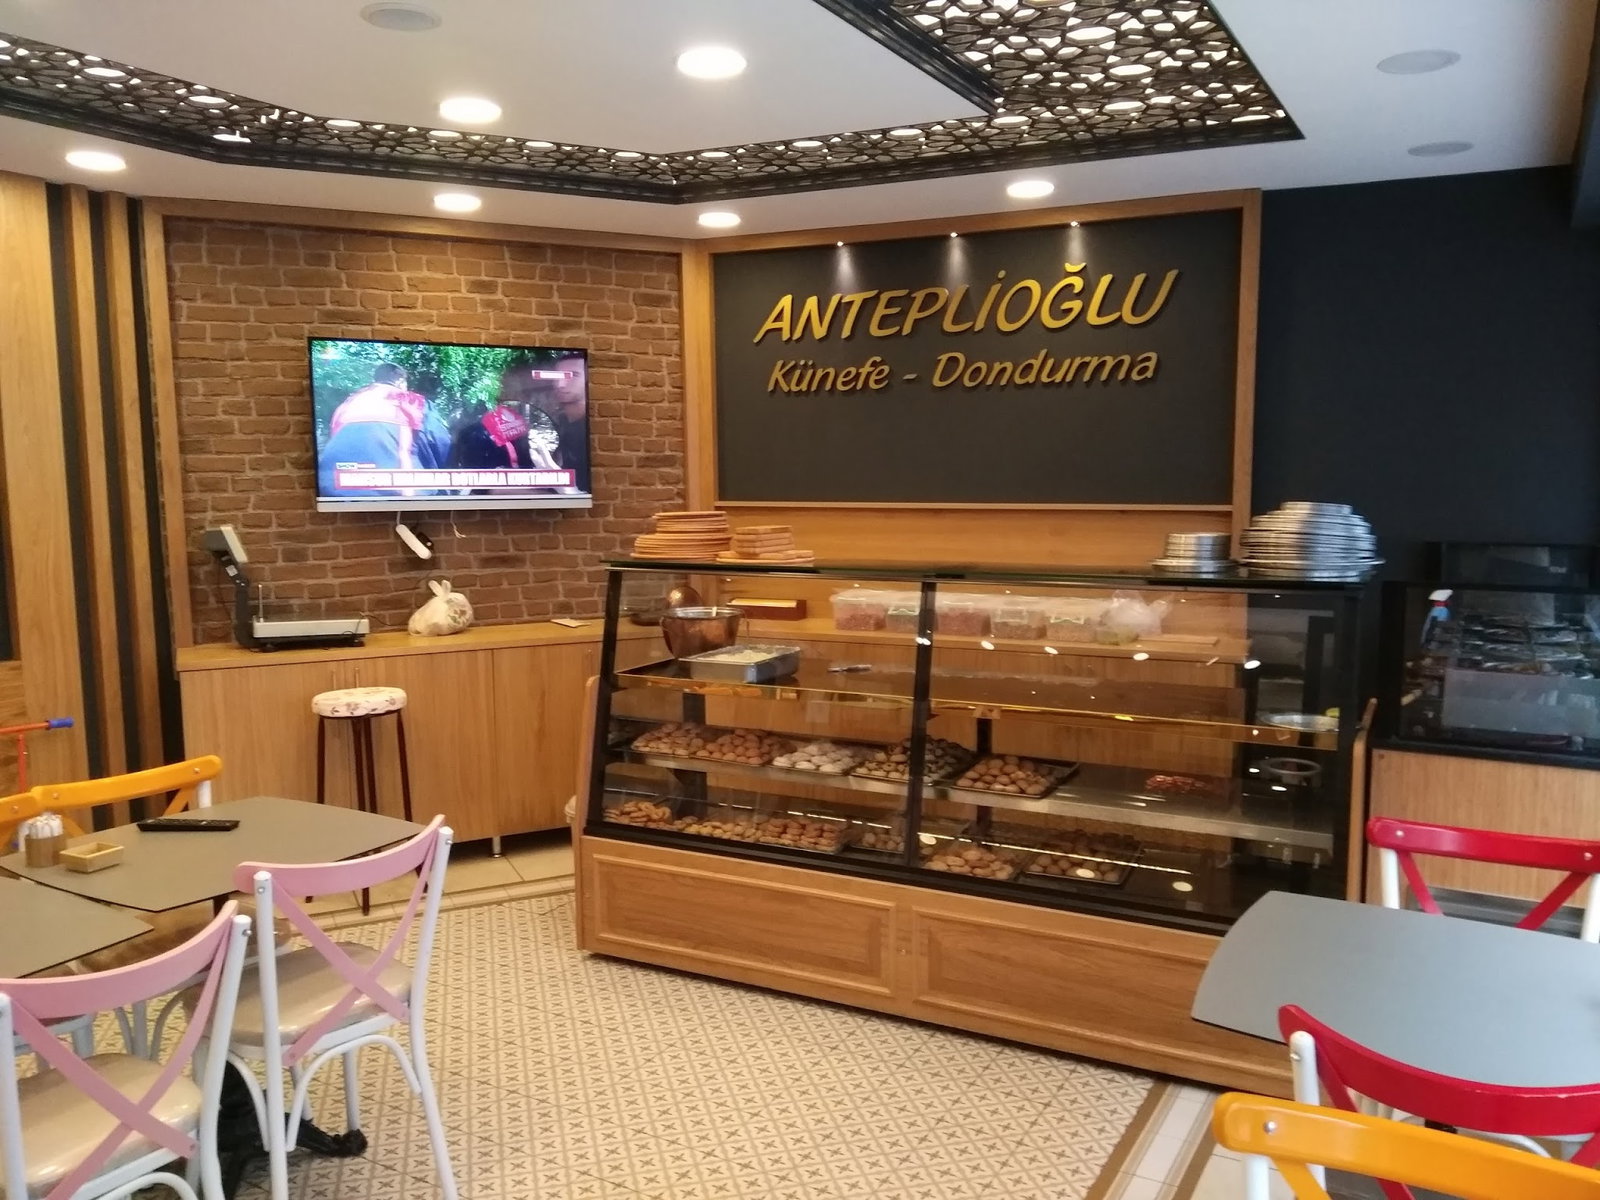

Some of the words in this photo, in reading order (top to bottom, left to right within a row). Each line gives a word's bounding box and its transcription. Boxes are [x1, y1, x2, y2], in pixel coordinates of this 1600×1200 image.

[753, 262, 1179, 343] ANTEPLİOĞLU
[767, 356, 891, 392] Künefe
[932, 349, 1158, 388] Dondurma
